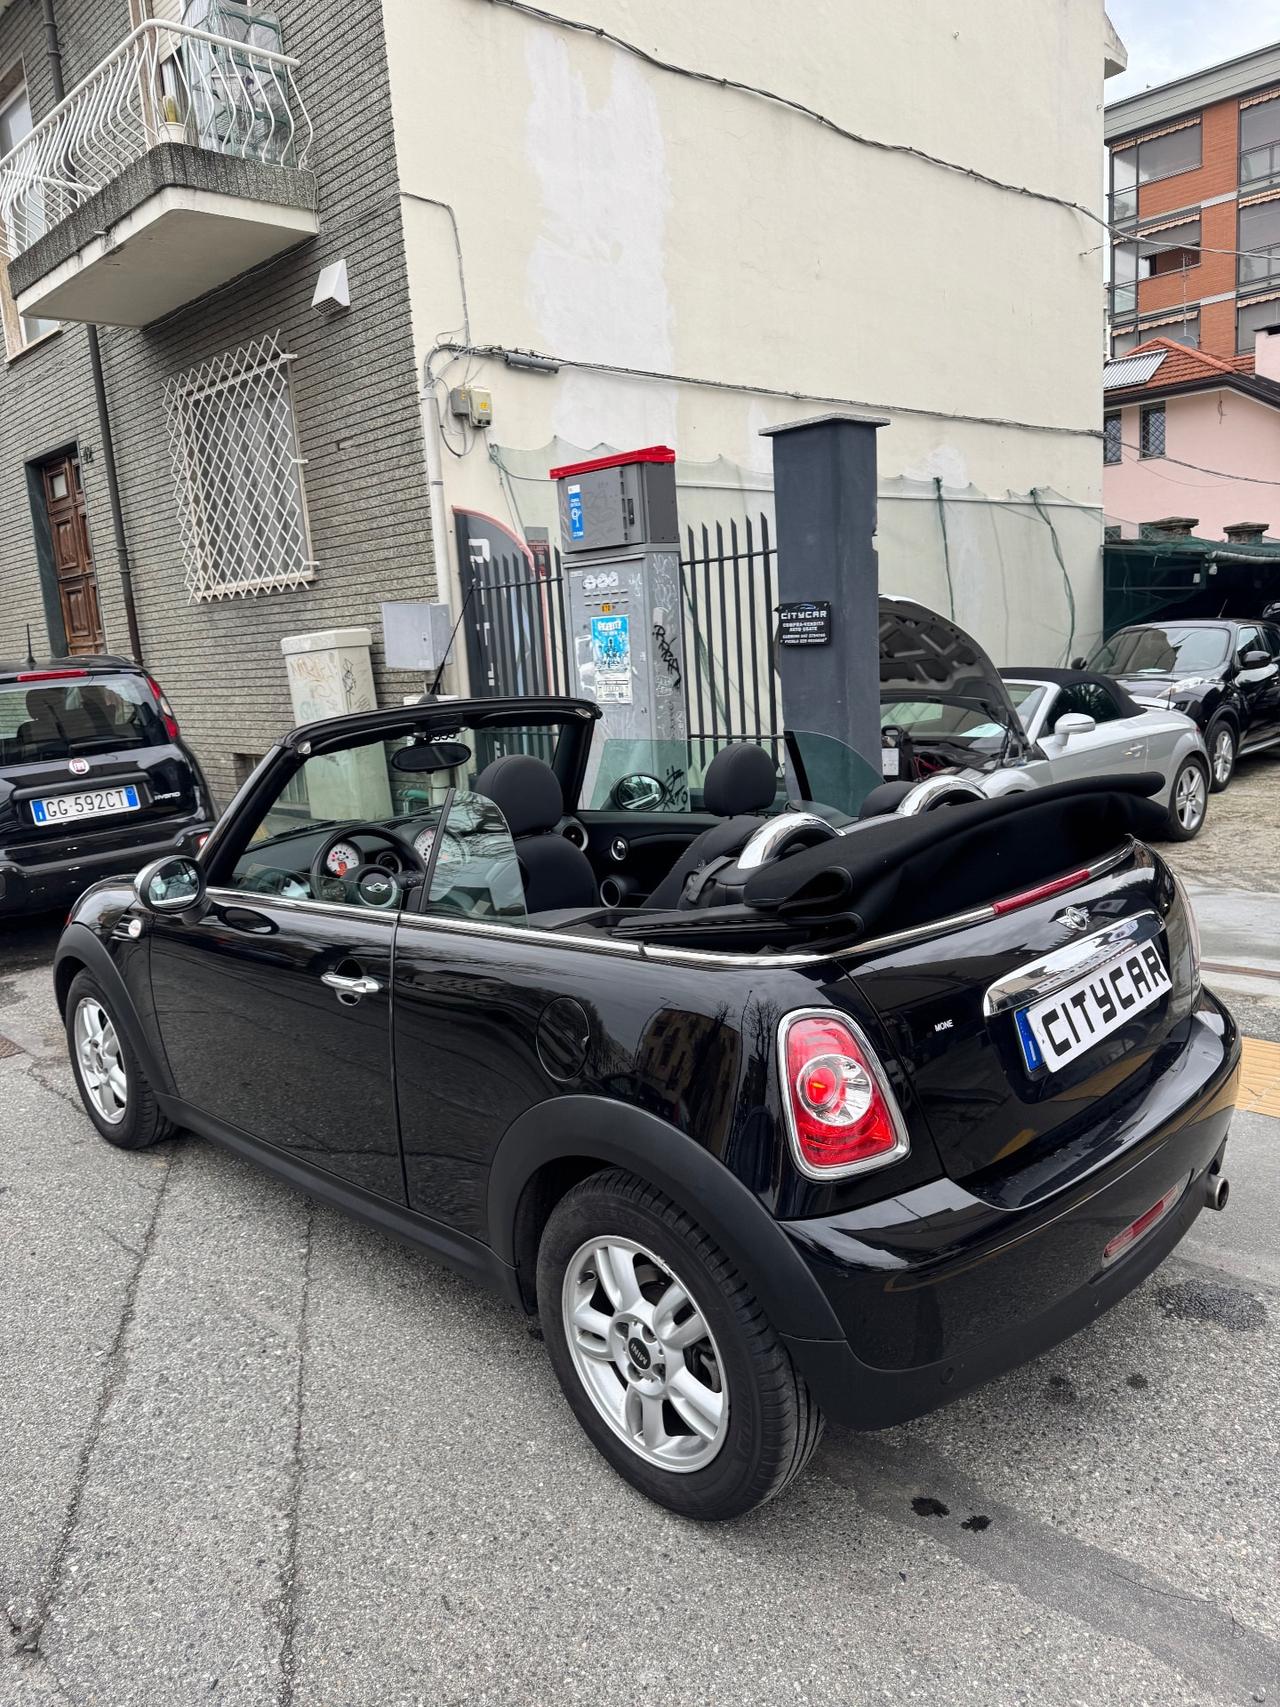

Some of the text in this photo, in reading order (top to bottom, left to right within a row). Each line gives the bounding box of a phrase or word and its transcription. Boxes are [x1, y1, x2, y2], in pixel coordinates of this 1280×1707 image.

[780, 611, 827, 619] CITYCAR
[46, 799, 68, 818] GG
[74, 789, 124, 814] 592CT
[1041, 945, 1167, 1057] CITYCAR
